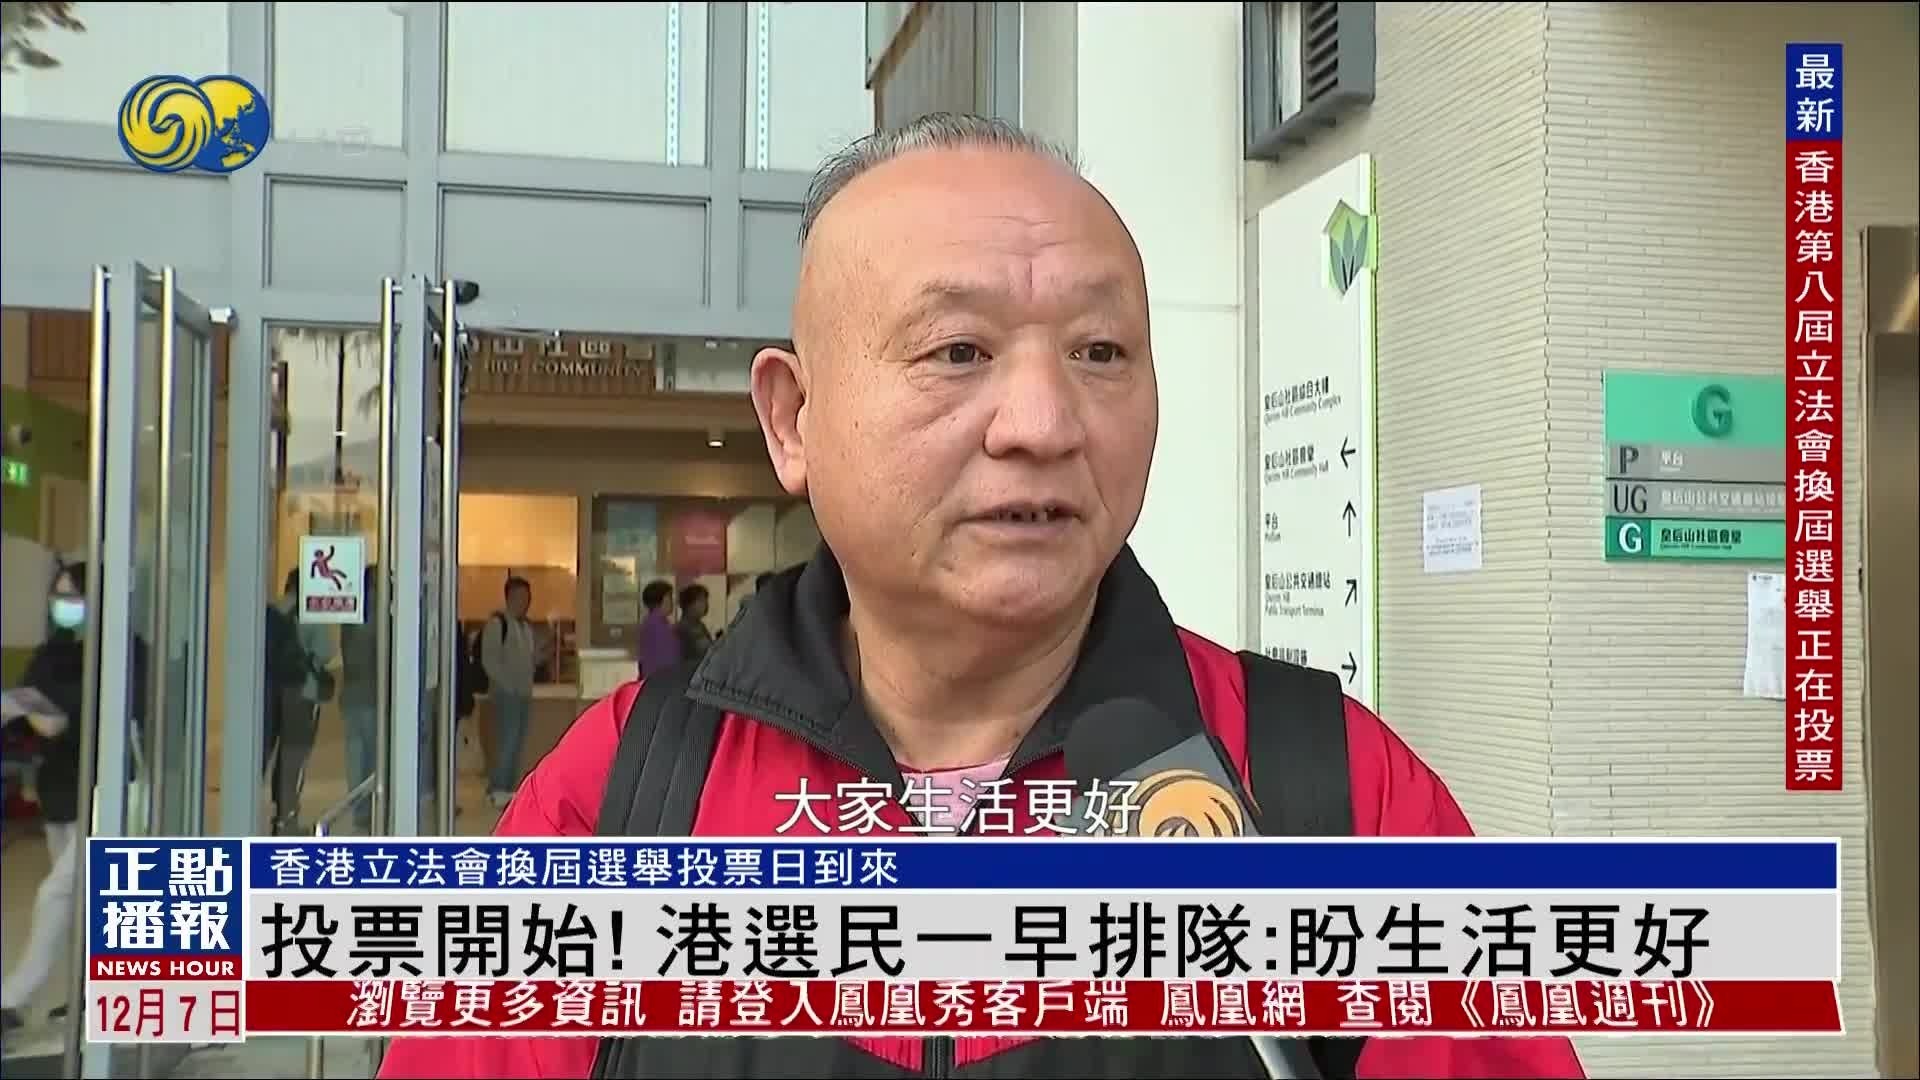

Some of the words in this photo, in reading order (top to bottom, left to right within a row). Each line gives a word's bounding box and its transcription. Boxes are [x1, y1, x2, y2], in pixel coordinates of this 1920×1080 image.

[532, 360, 641, 377] COMMUNITY
[1694, 384, 1733, 437] G
[1619, 446, 1639, 474] P
[1613, 484, 1648, 514] UG
[1619, 522, 1643, 553] G
